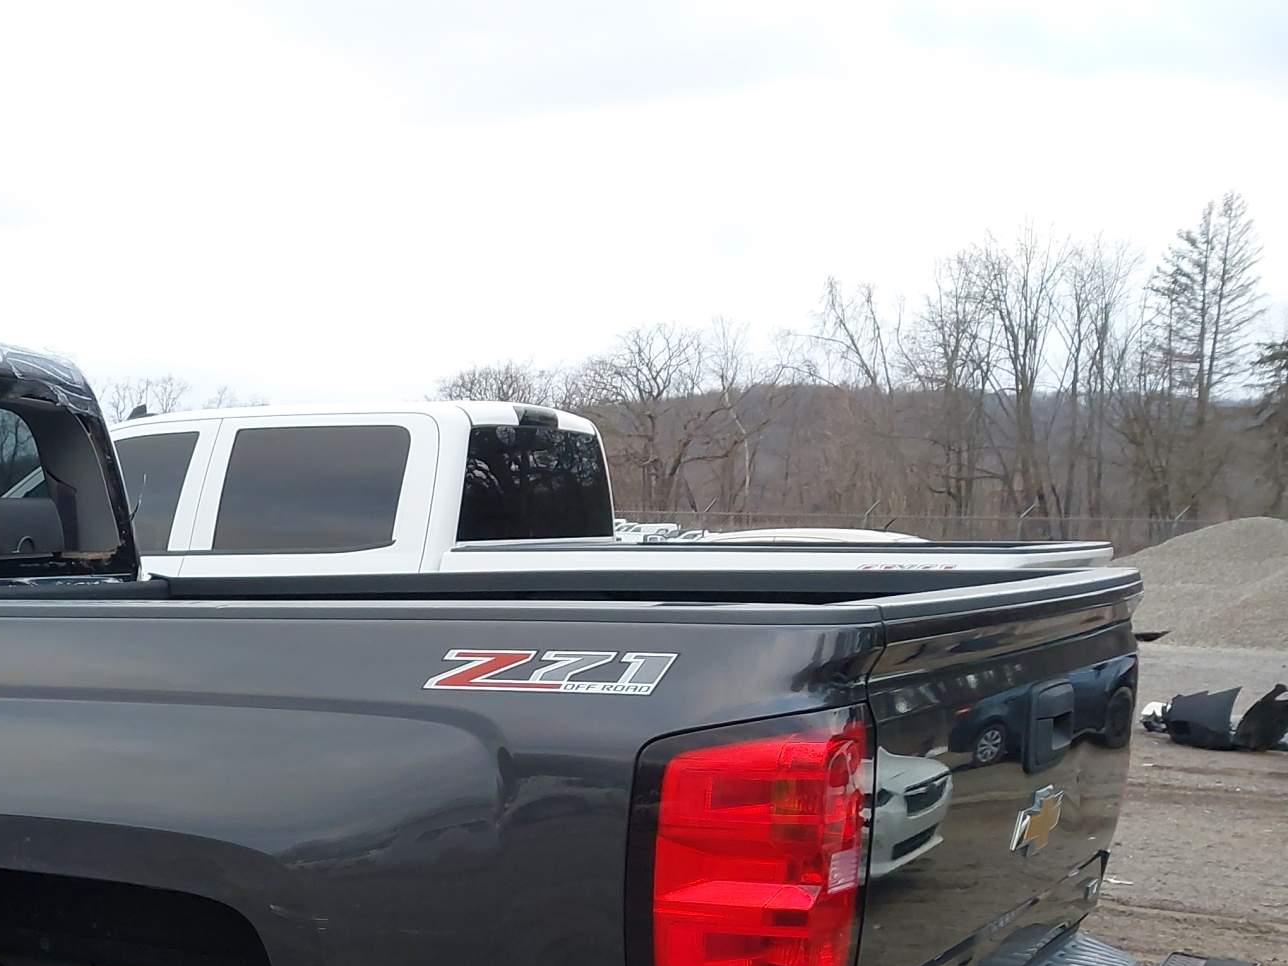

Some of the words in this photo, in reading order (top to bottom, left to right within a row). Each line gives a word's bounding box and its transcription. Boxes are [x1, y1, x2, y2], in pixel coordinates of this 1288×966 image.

[423, 649, 680, 695] Z71
[563, 683, 599, 691] OFF
[602, 684, 652, 693] ROAD
